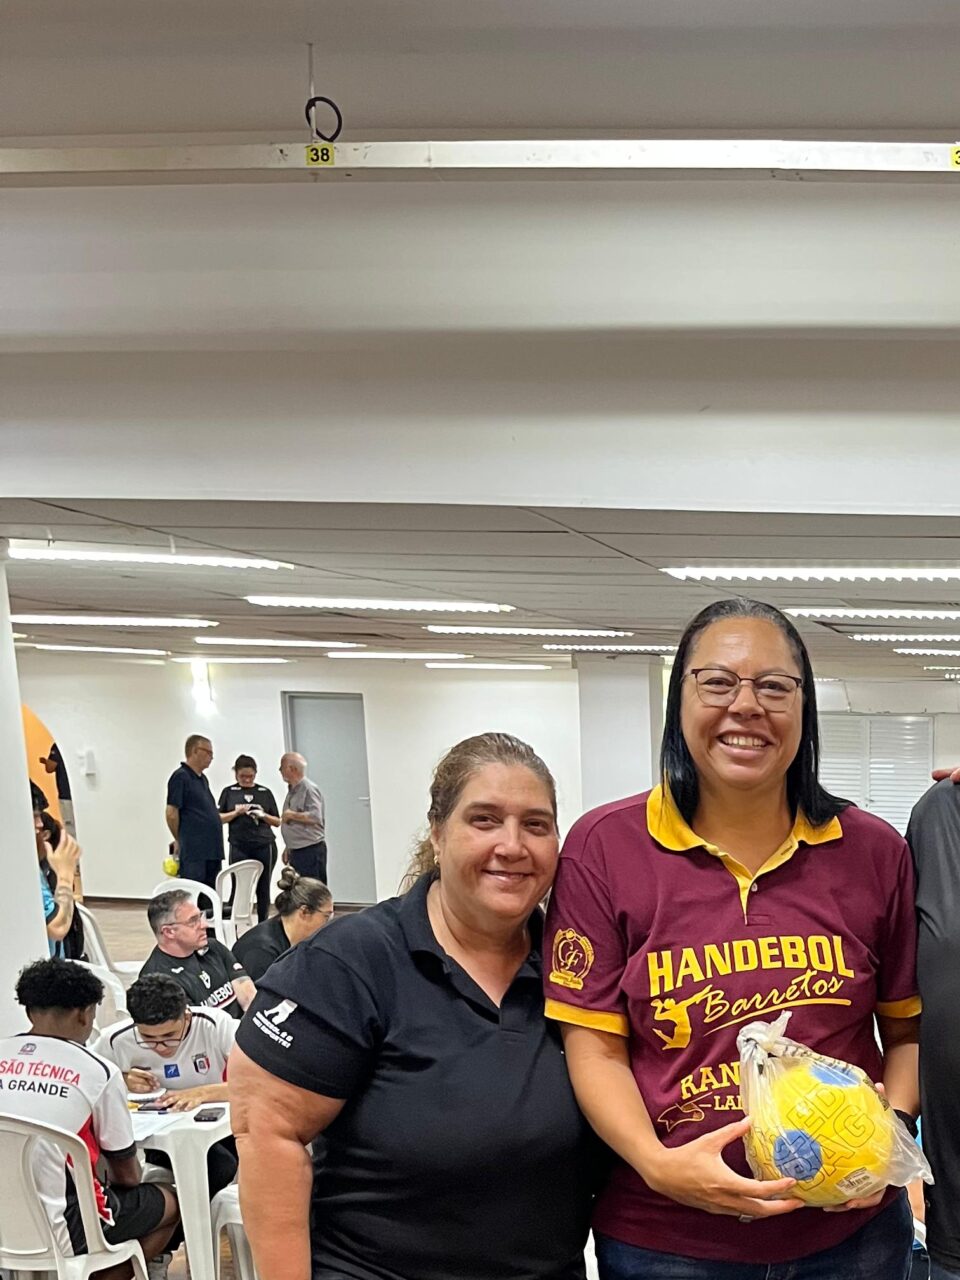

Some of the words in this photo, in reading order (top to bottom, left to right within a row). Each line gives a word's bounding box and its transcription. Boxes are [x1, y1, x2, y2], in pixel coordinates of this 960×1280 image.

[310, 147, 330, 162] 38
[646, 934, 855, 998] HANDEBOL
[698, 968, 845, 1023] Barretos
[28, 1060, 81, 1086] TÉCNICA
[8, 1079, 70, 1099] GRANDE
